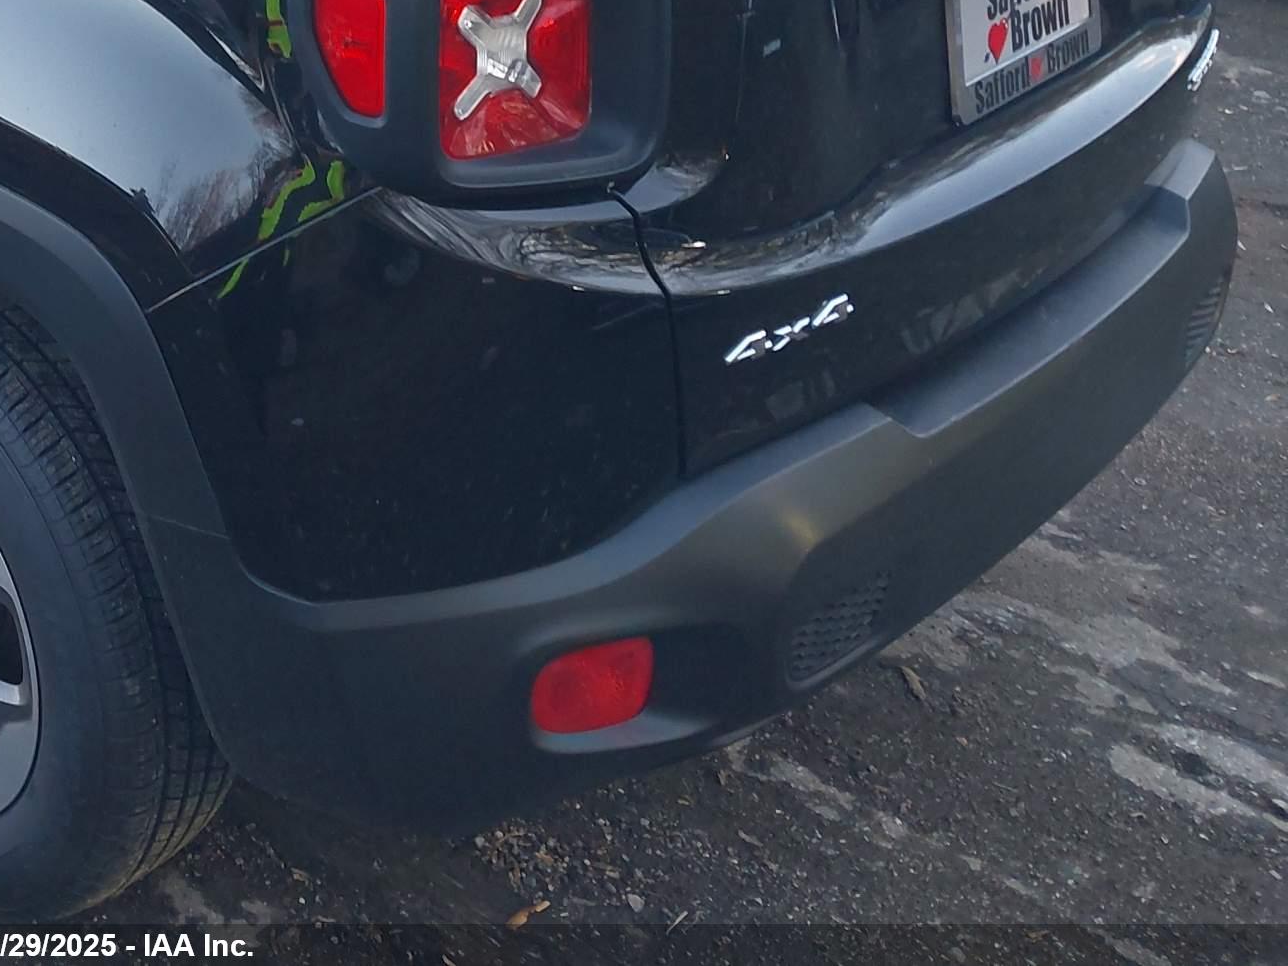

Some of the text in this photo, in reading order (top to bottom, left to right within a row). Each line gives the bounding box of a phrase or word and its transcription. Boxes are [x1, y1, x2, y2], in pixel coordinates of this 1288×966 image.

[974, 29, 1090, 114] Safford Brown
[724, 292, 854, 366] 4x4
